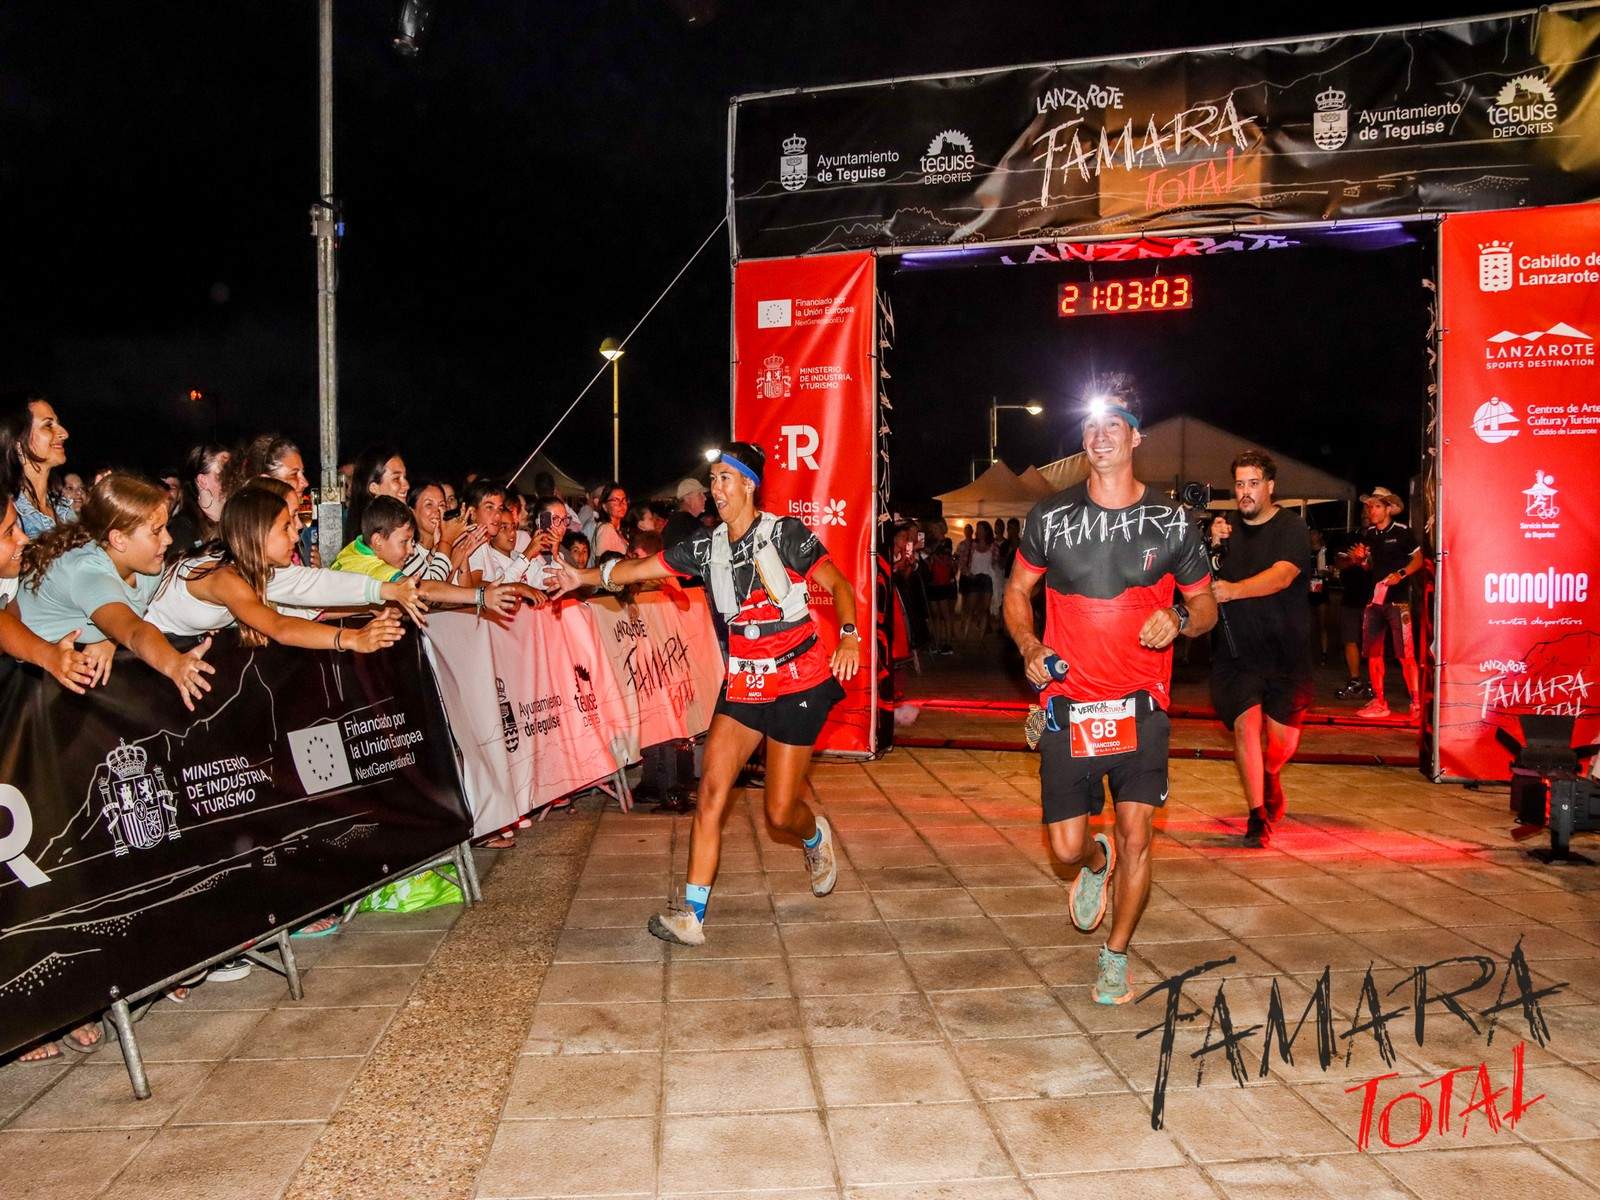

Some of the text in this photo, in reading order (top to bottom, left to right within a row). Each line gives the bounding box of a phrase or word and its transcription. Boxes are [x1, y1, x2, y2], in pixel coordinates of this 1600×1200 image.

[1036, 84, 1124, 114] LANZAROTE
[1359, 101, 1461, 126] Ayuntamiento
[1359, 121, 1445, 141] de Teguise
[1493, 122, 1554, 139] DEPORTES
[1032, 92, 1258, 208] FAMARA
[817, 151, 900, 170] Ayuntamiento
[817, 166, 887, 183] de Teguise
[924, 172, 972, 185] DEPORTES
[1139, 147, 1244, 211] TOTAL
[1518, 251, 1600, 270] Cabildo de
[1519, 269, 1600, 286] Lanzarote
[795, 298, 833, 307] Financiado
[1061, 277, 1189, 314] 21:03:03
[1486, 343, 1595, 360] LANZAROTE
[799, 366, 842, 375] MINISTERIO
[1486, 358, 1595, 370] SPORTS DESTINATION
[799, 375, 810, 383] DE
[806, 381, 839, 390] TURISMO
[1527, 404, 1566, 415] Centros
[1566, 403, 1579, 413] de
[1527, 416, 1560, 426] Cultura
[788, 500, 820, 514] Islas
[1041, 502, 1189, 556] FAMARA
[1484, 566, 1589, 609] cronoline
[1479, 658, 1528, 674] LANZAROTE
[1477, 669, 1595, 719] FAMARA
[344, 712, 406, 737] Financiado por
[1091, 720, 1117, 739] 98
[350, 730, 424, 760] la Unión Europea
[182, 756, 249, 782] MINISTERIO
[186, 769, 273, 800] DE INDUSTRIA,
[192, 788, 256, 816] Y TURISMO
